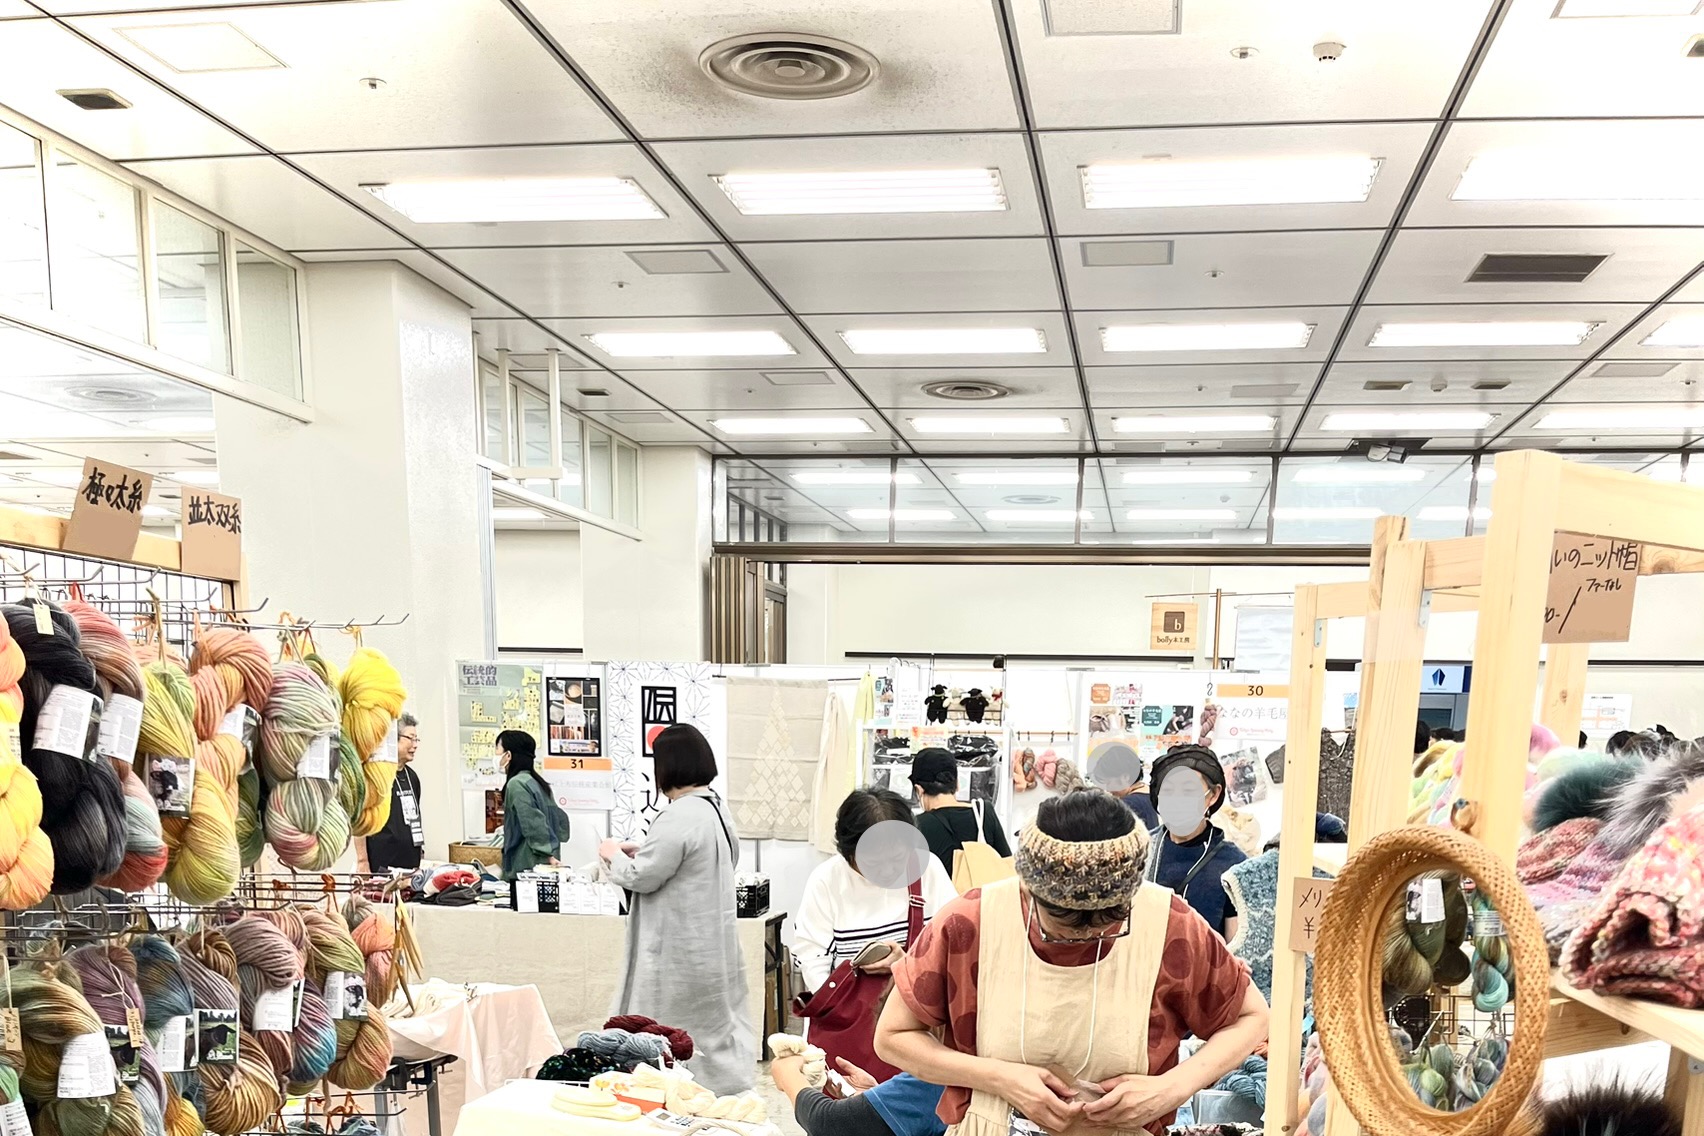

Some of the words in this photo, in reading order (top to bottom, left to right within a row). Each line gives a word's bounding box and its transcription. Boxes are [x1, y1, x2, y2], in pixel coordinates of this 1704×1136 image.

[1549, 540, 1638, 574] いのニット帽
[1174, 619, 1182, 631] b
[1247, 685, 1264, 696] 30
[570, 758, 584, 769] 31
